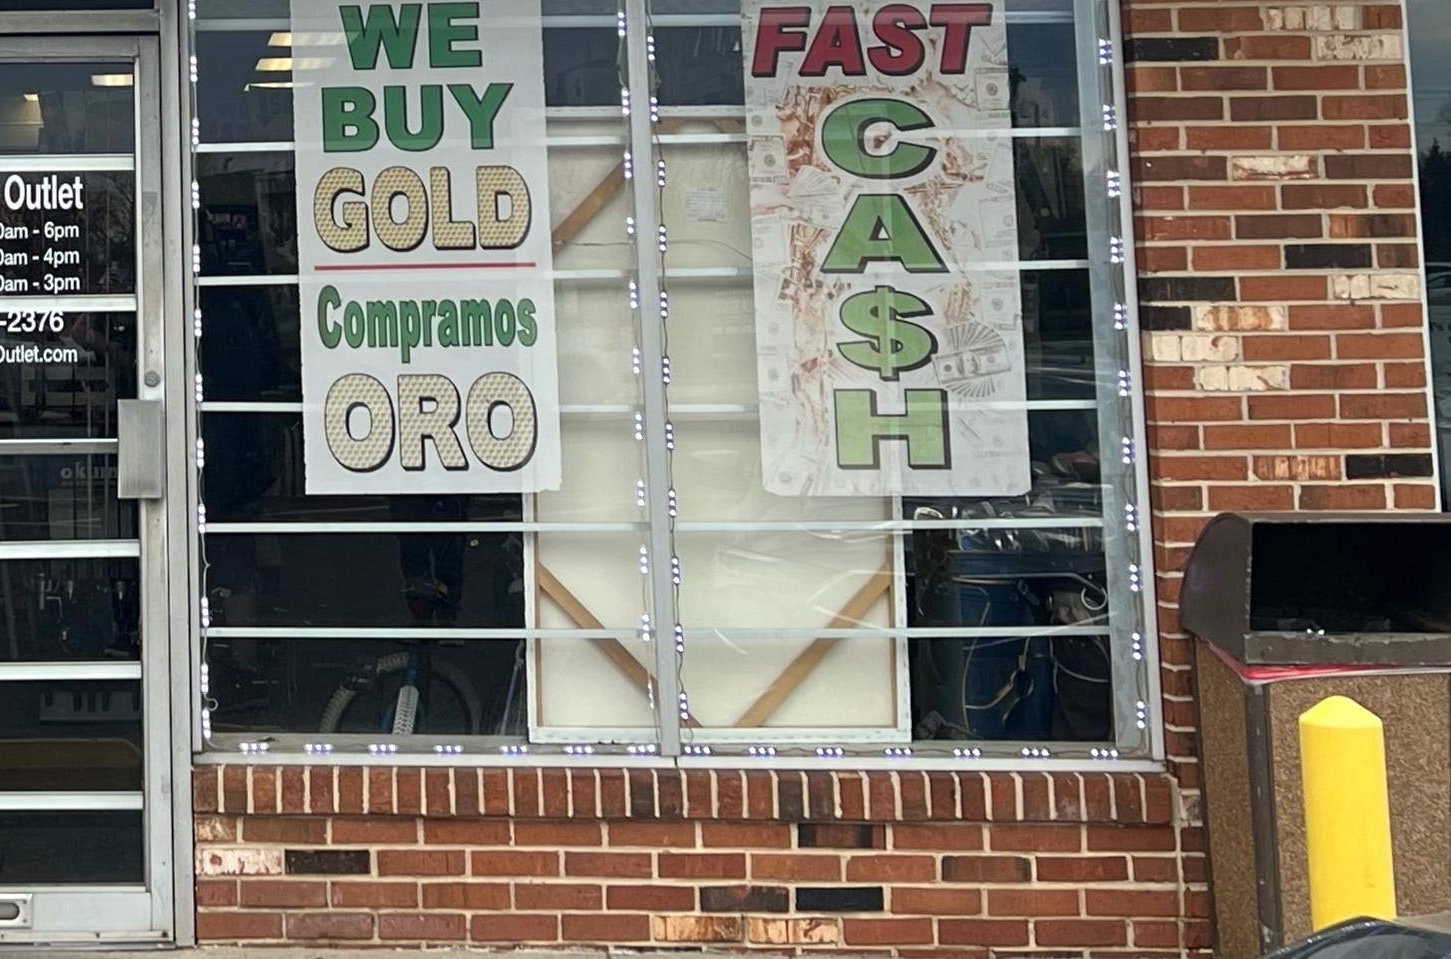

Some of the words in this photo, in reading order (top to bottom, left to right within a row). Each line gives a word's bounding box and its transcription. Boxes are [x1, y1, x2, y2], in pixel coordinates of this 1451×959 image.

[338, 1, 484, 71] WE
[751, 3, 993, 79] FAST
[321, 82, 515, 153] BUY
[3, 173, 84, 211] Outlet
[313, 165, 532, 254] GOLD
[43, 221, 80, 244] 6pm
[43, 247, 81, 269] 4pm
[43, 273, 81, 296] 3pm
[317, 284, 538, 364] Compramos
[324, 371, 538, 473] ORO
